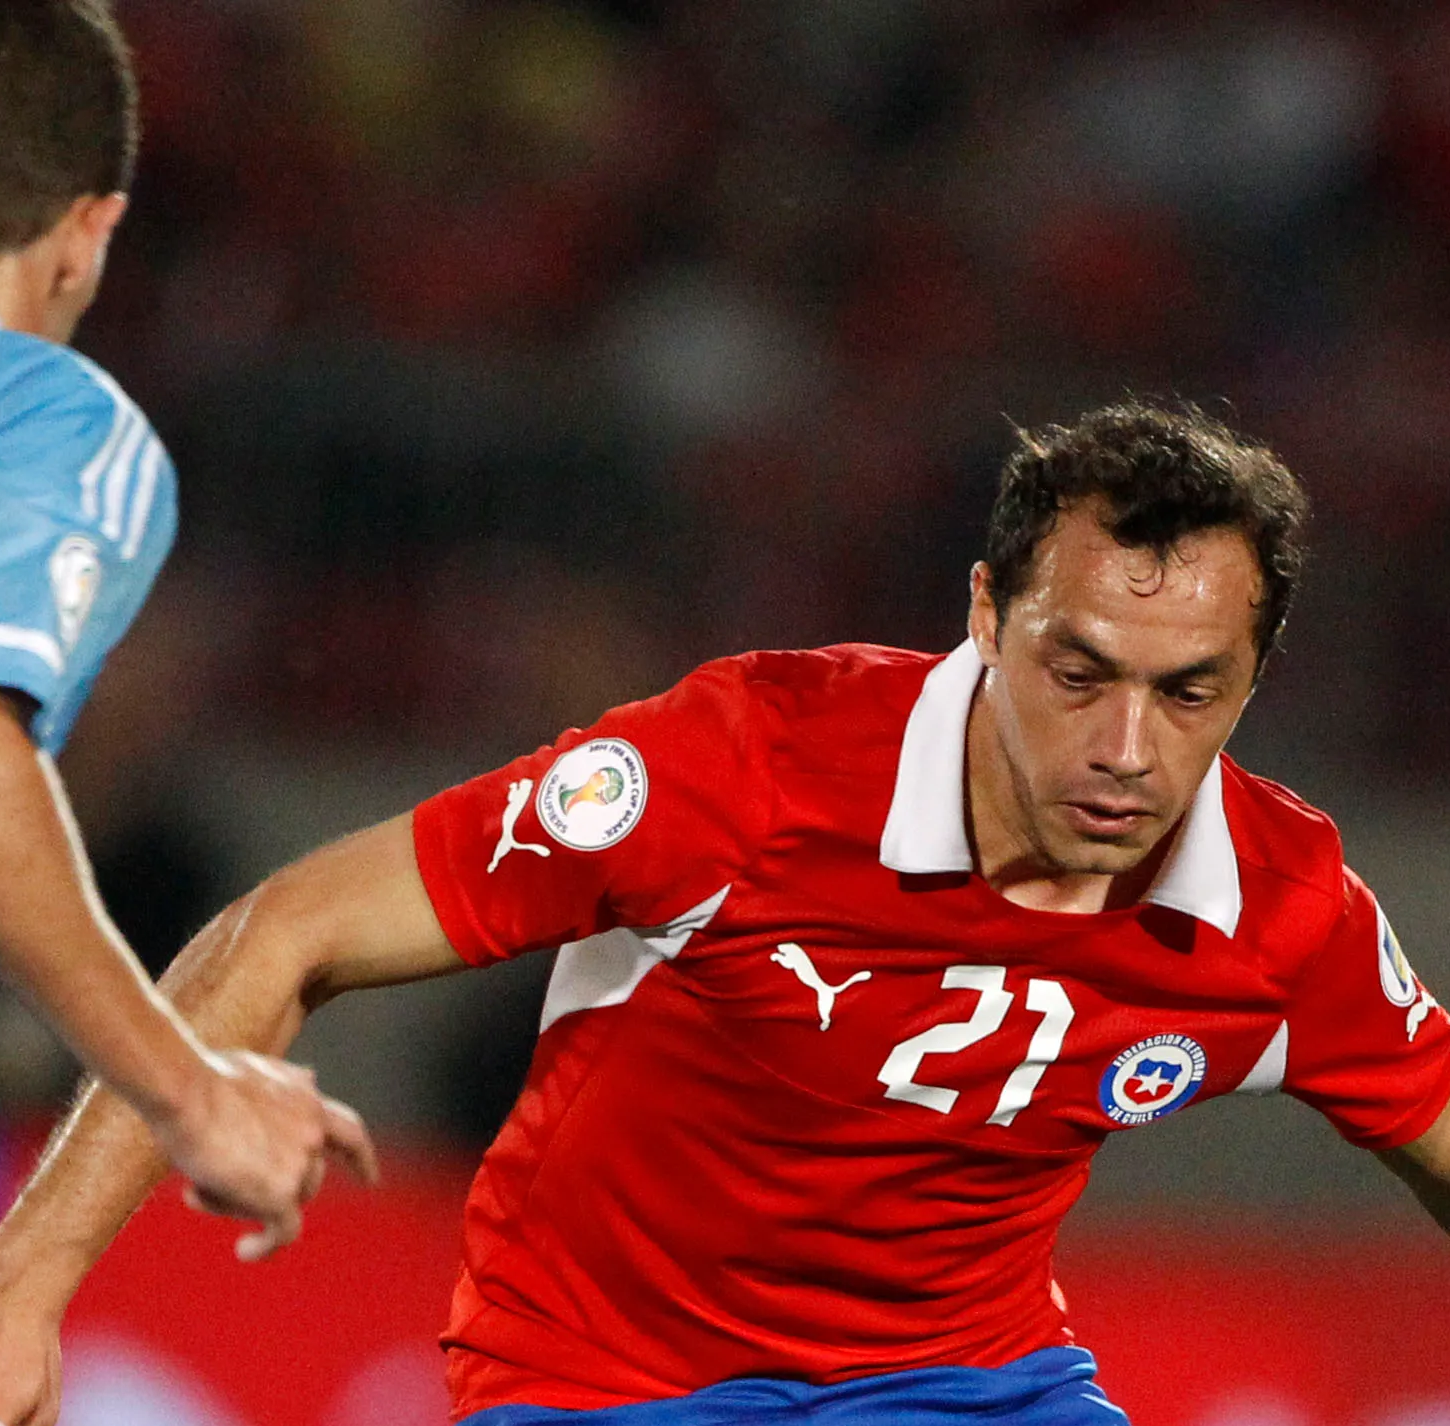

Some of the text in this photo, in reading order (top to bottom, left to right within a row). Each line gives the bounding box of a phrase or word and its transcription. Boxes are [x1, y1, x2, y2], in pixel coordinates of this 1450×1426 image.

[877, 965, 1074, 1127] 21
[1108, 1107, 1153, 1124] DE CHILE
